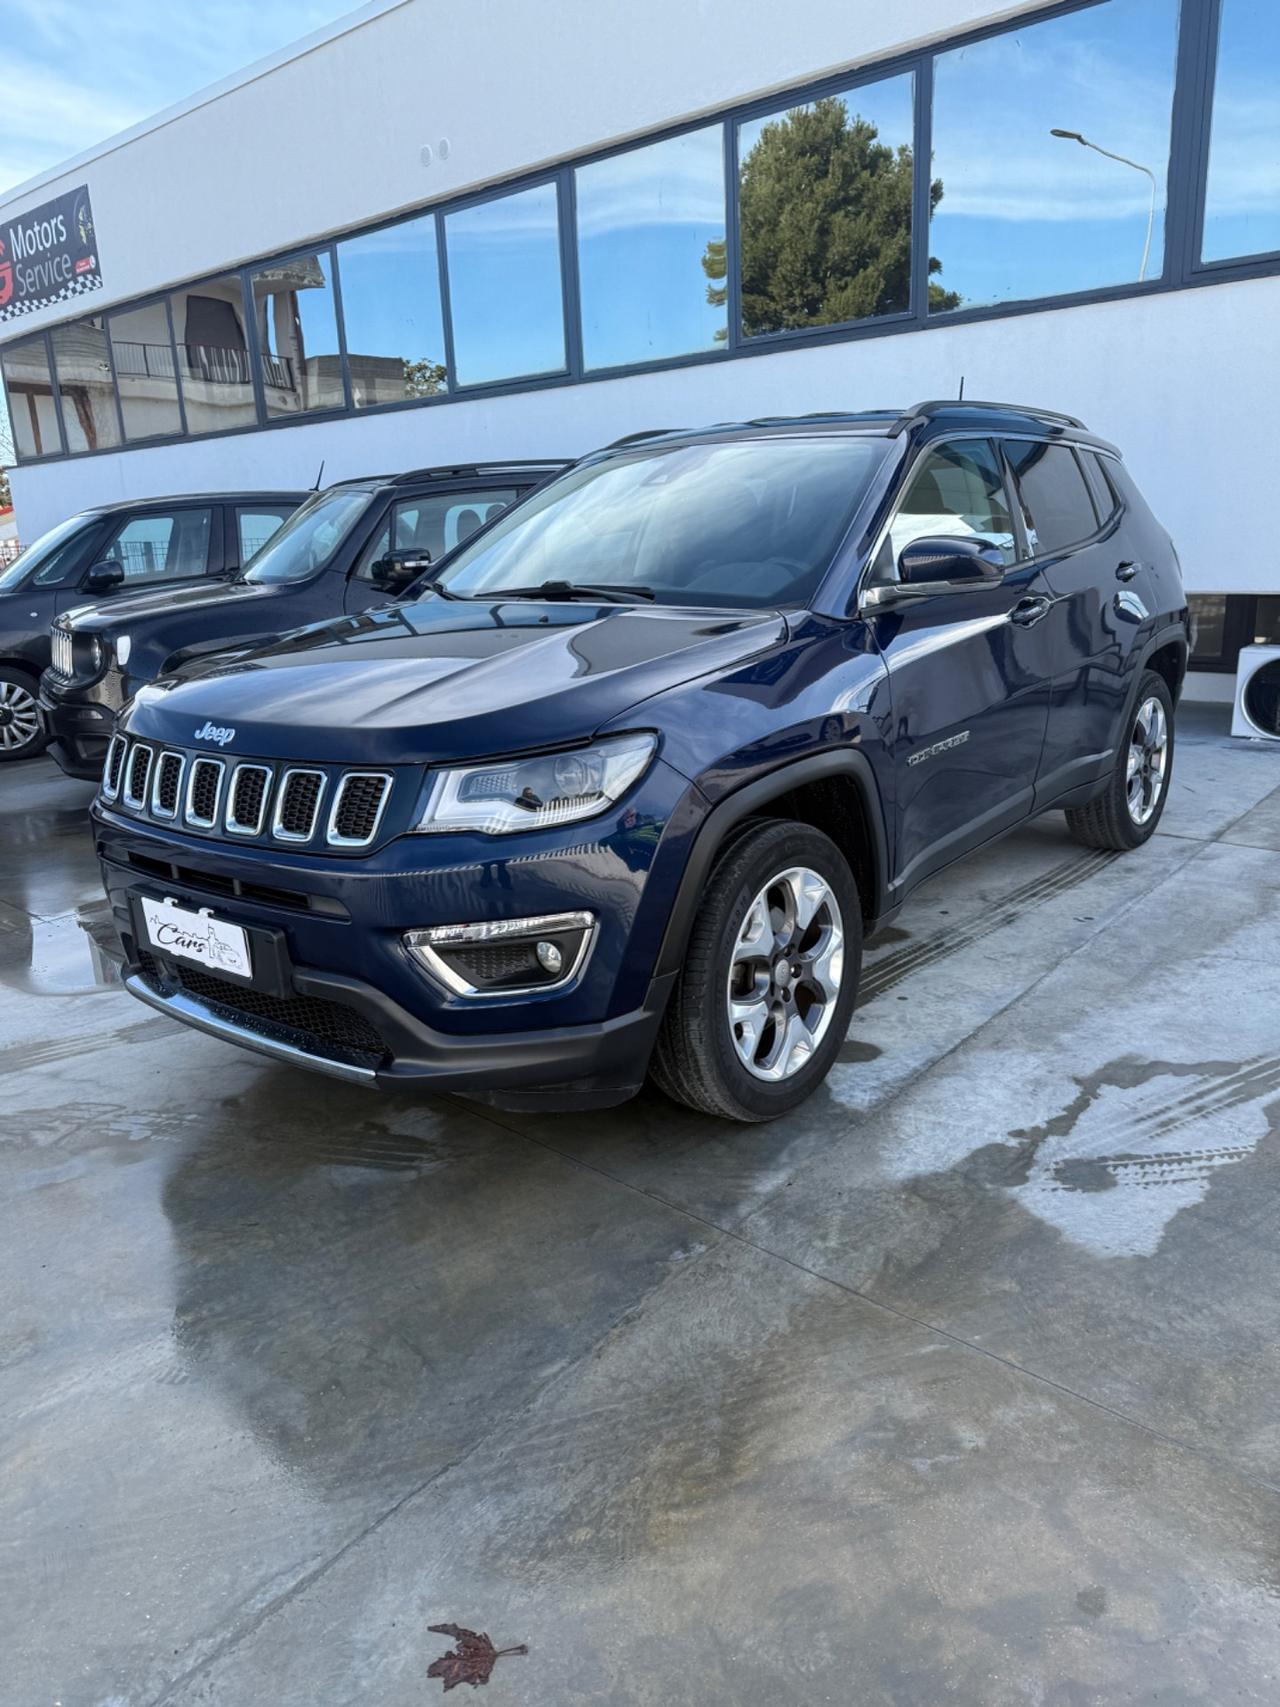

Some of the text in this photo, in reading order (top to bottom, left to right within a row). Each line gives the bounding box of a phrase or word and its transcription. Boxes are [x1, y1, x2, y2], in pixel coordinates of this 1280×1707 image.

[9, 214, 67, 262] Motors
[16, 252, 73, 297] Service
[194, 721, 236, 747] Jeep
[157, 922, 207, 952] Cars
